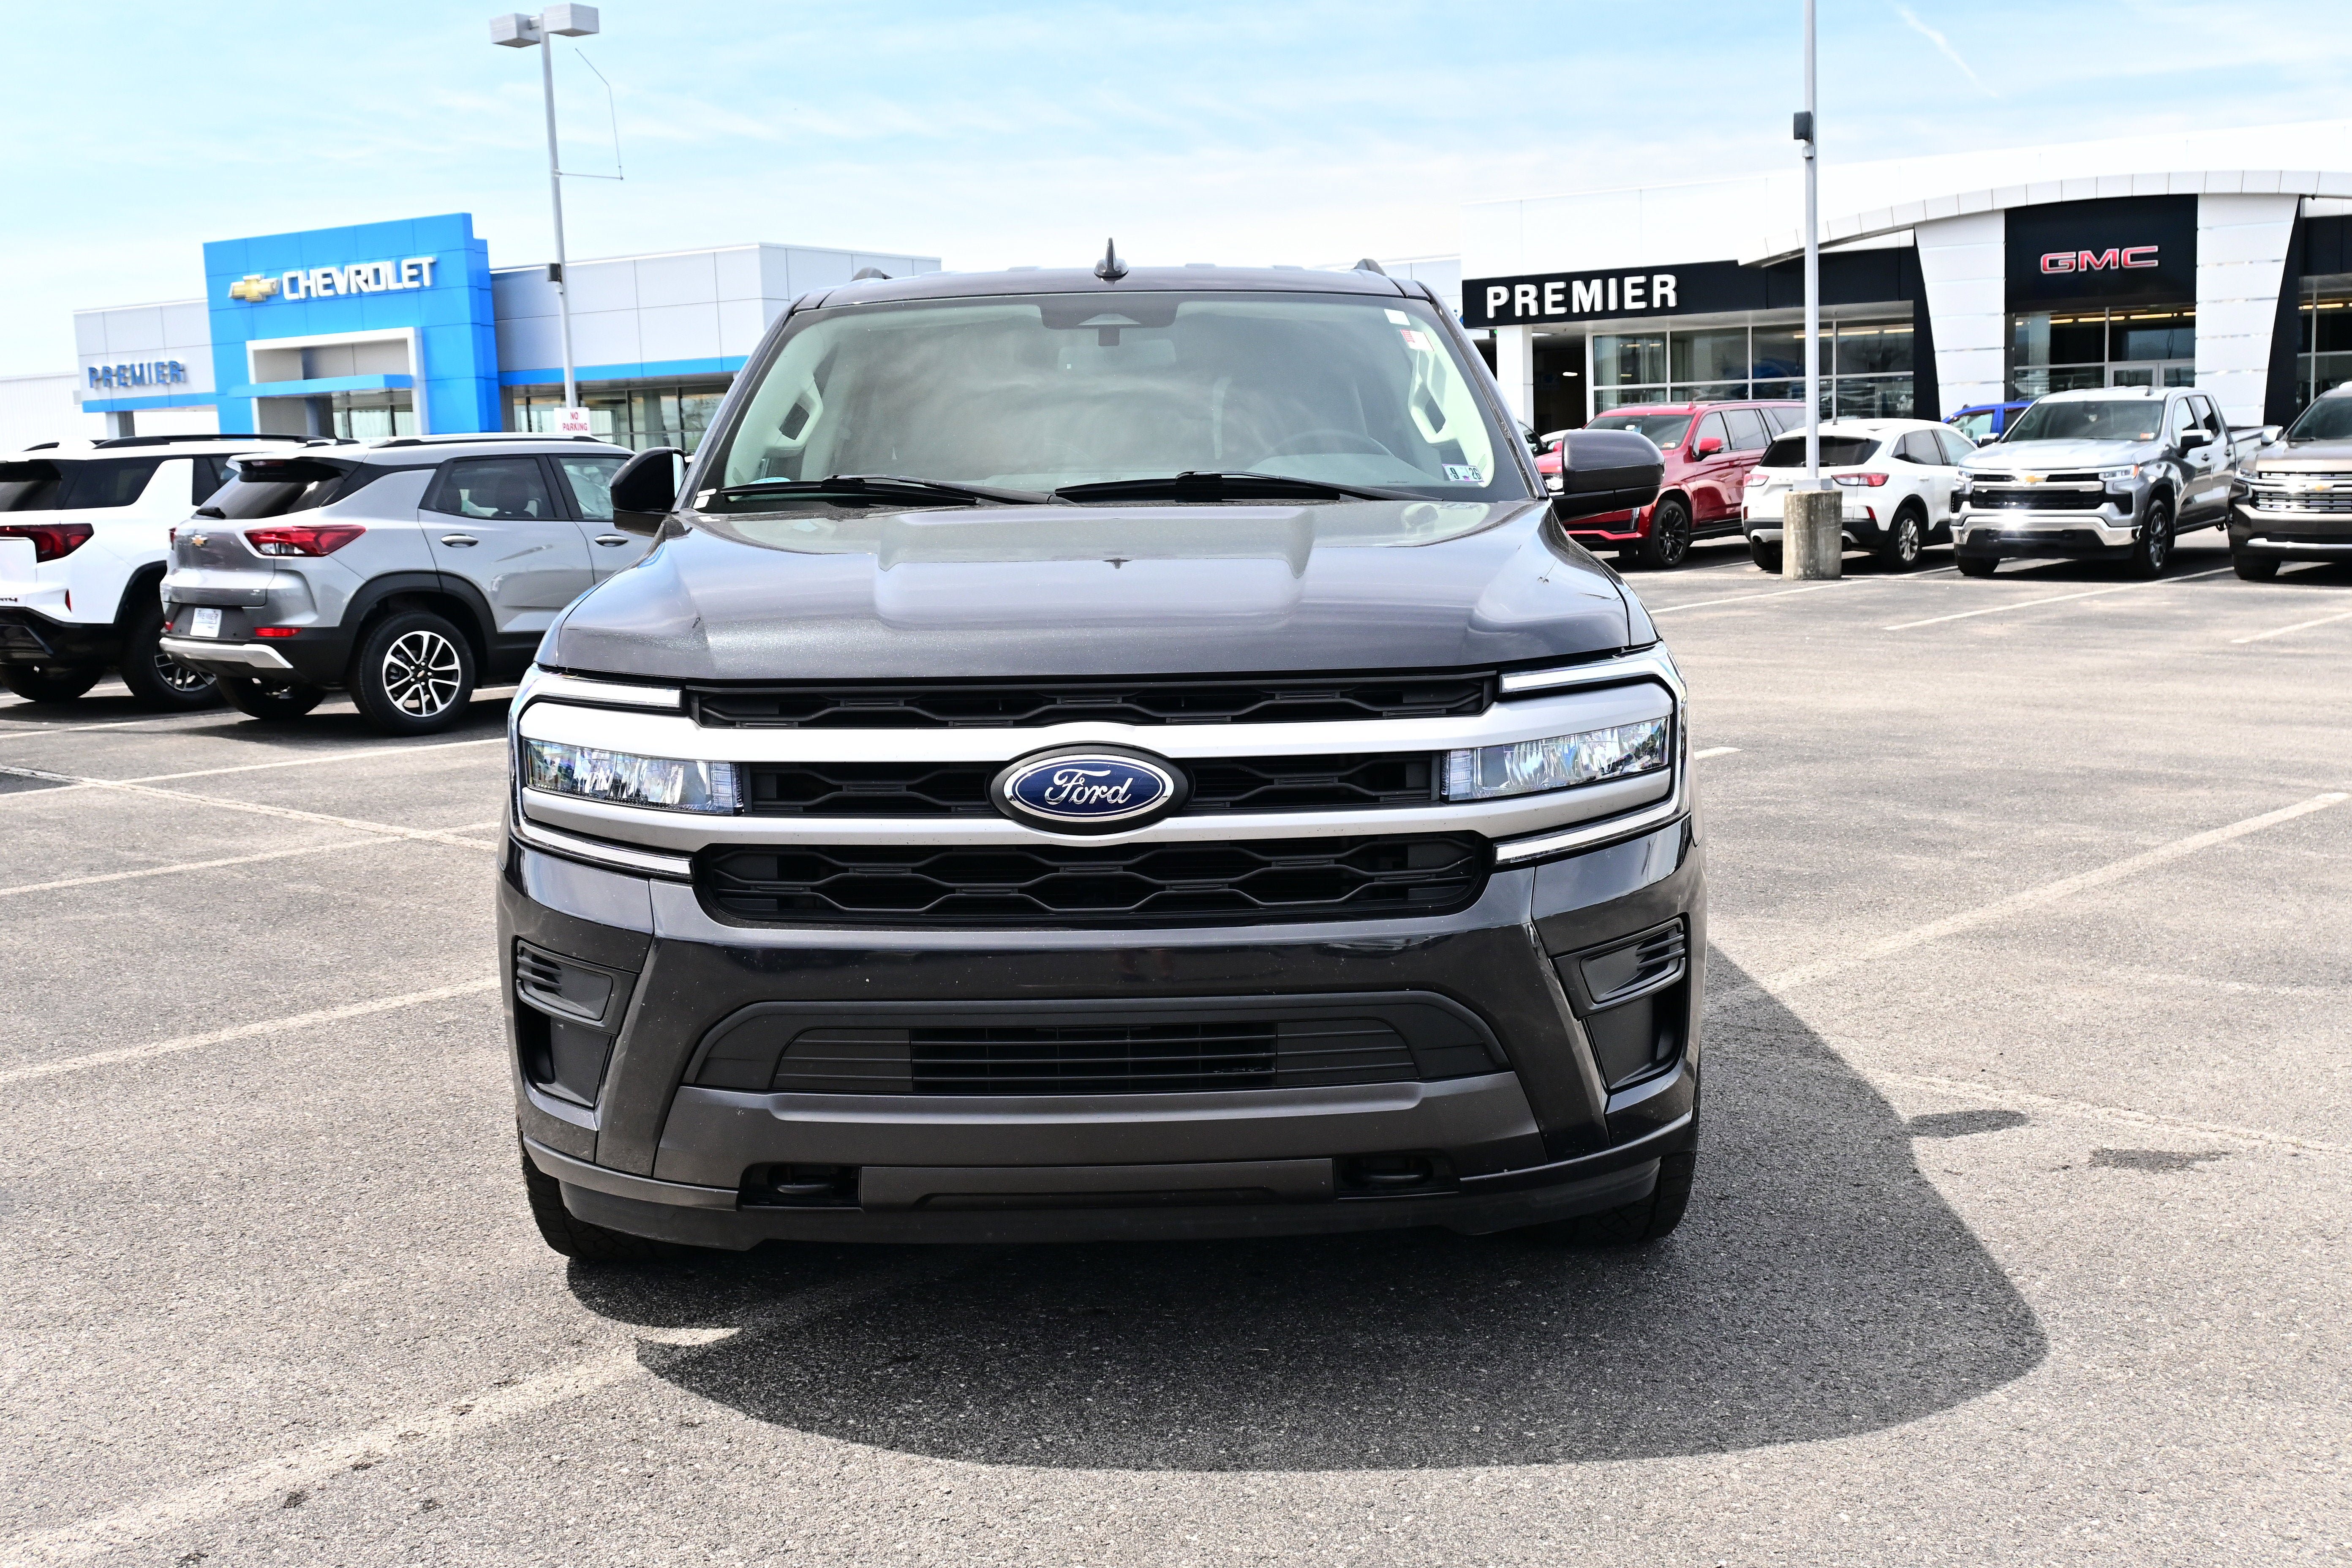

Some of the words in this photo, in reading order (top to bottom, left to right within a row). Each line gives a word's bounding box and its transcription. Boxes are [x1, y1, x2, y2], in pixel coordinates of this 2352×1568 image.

[2041, 245, 2159, 274] GMC
[282, 256, 436, 300] CHEVROLET
[1486, 274, 1677, 318] PREMIER
[88, 360, 183, 388] PREMIER
[562, 422, 588, 431] PARKING
[570, 412, 578, 420] NO
[1449, 467, 1460, 479] 9
[1469, 467, 1481, 480] 26
[1044, 768, 1133, 805] Ford
